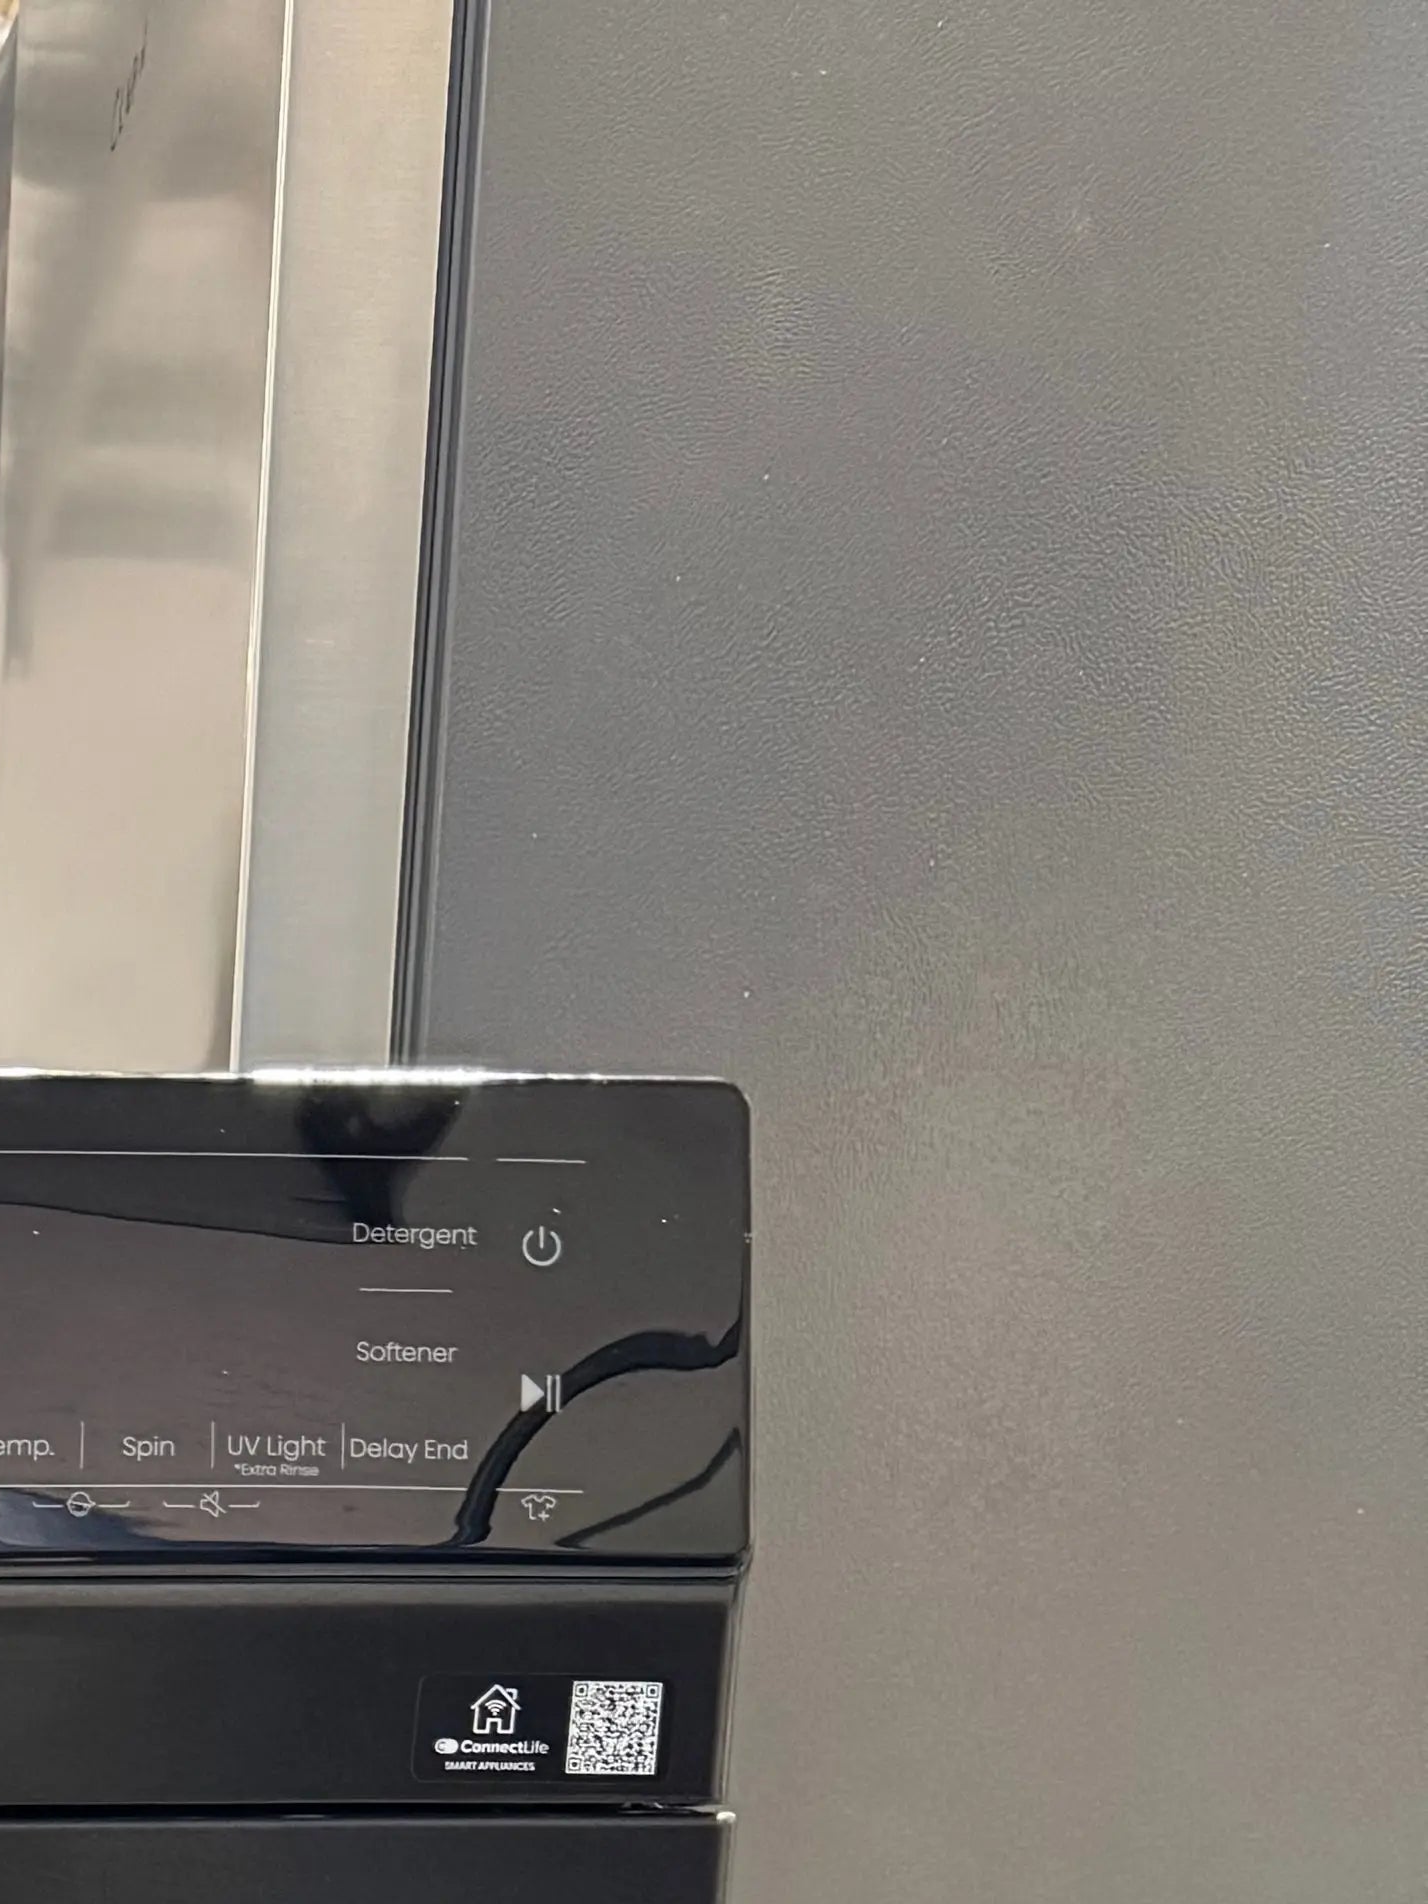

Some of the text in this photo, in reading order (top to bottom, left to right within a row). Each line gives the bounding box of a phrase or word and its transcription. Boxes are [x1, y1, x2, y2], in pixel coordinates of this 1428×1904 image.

[352, 1222, 478, 1250] Detergent
[356, 1341, 458, 1363] Softener
[122, 1434, 176, 1463] Spin
[228, 1435, 327, 1460] UV Light
[350, 1437, 468, 1464] Delay End
[280, 1465, 320, 1476] Rinse
[460, 1739, 549, 1754] ConnectLife
[445, 1762, 477, 1770] SMART
